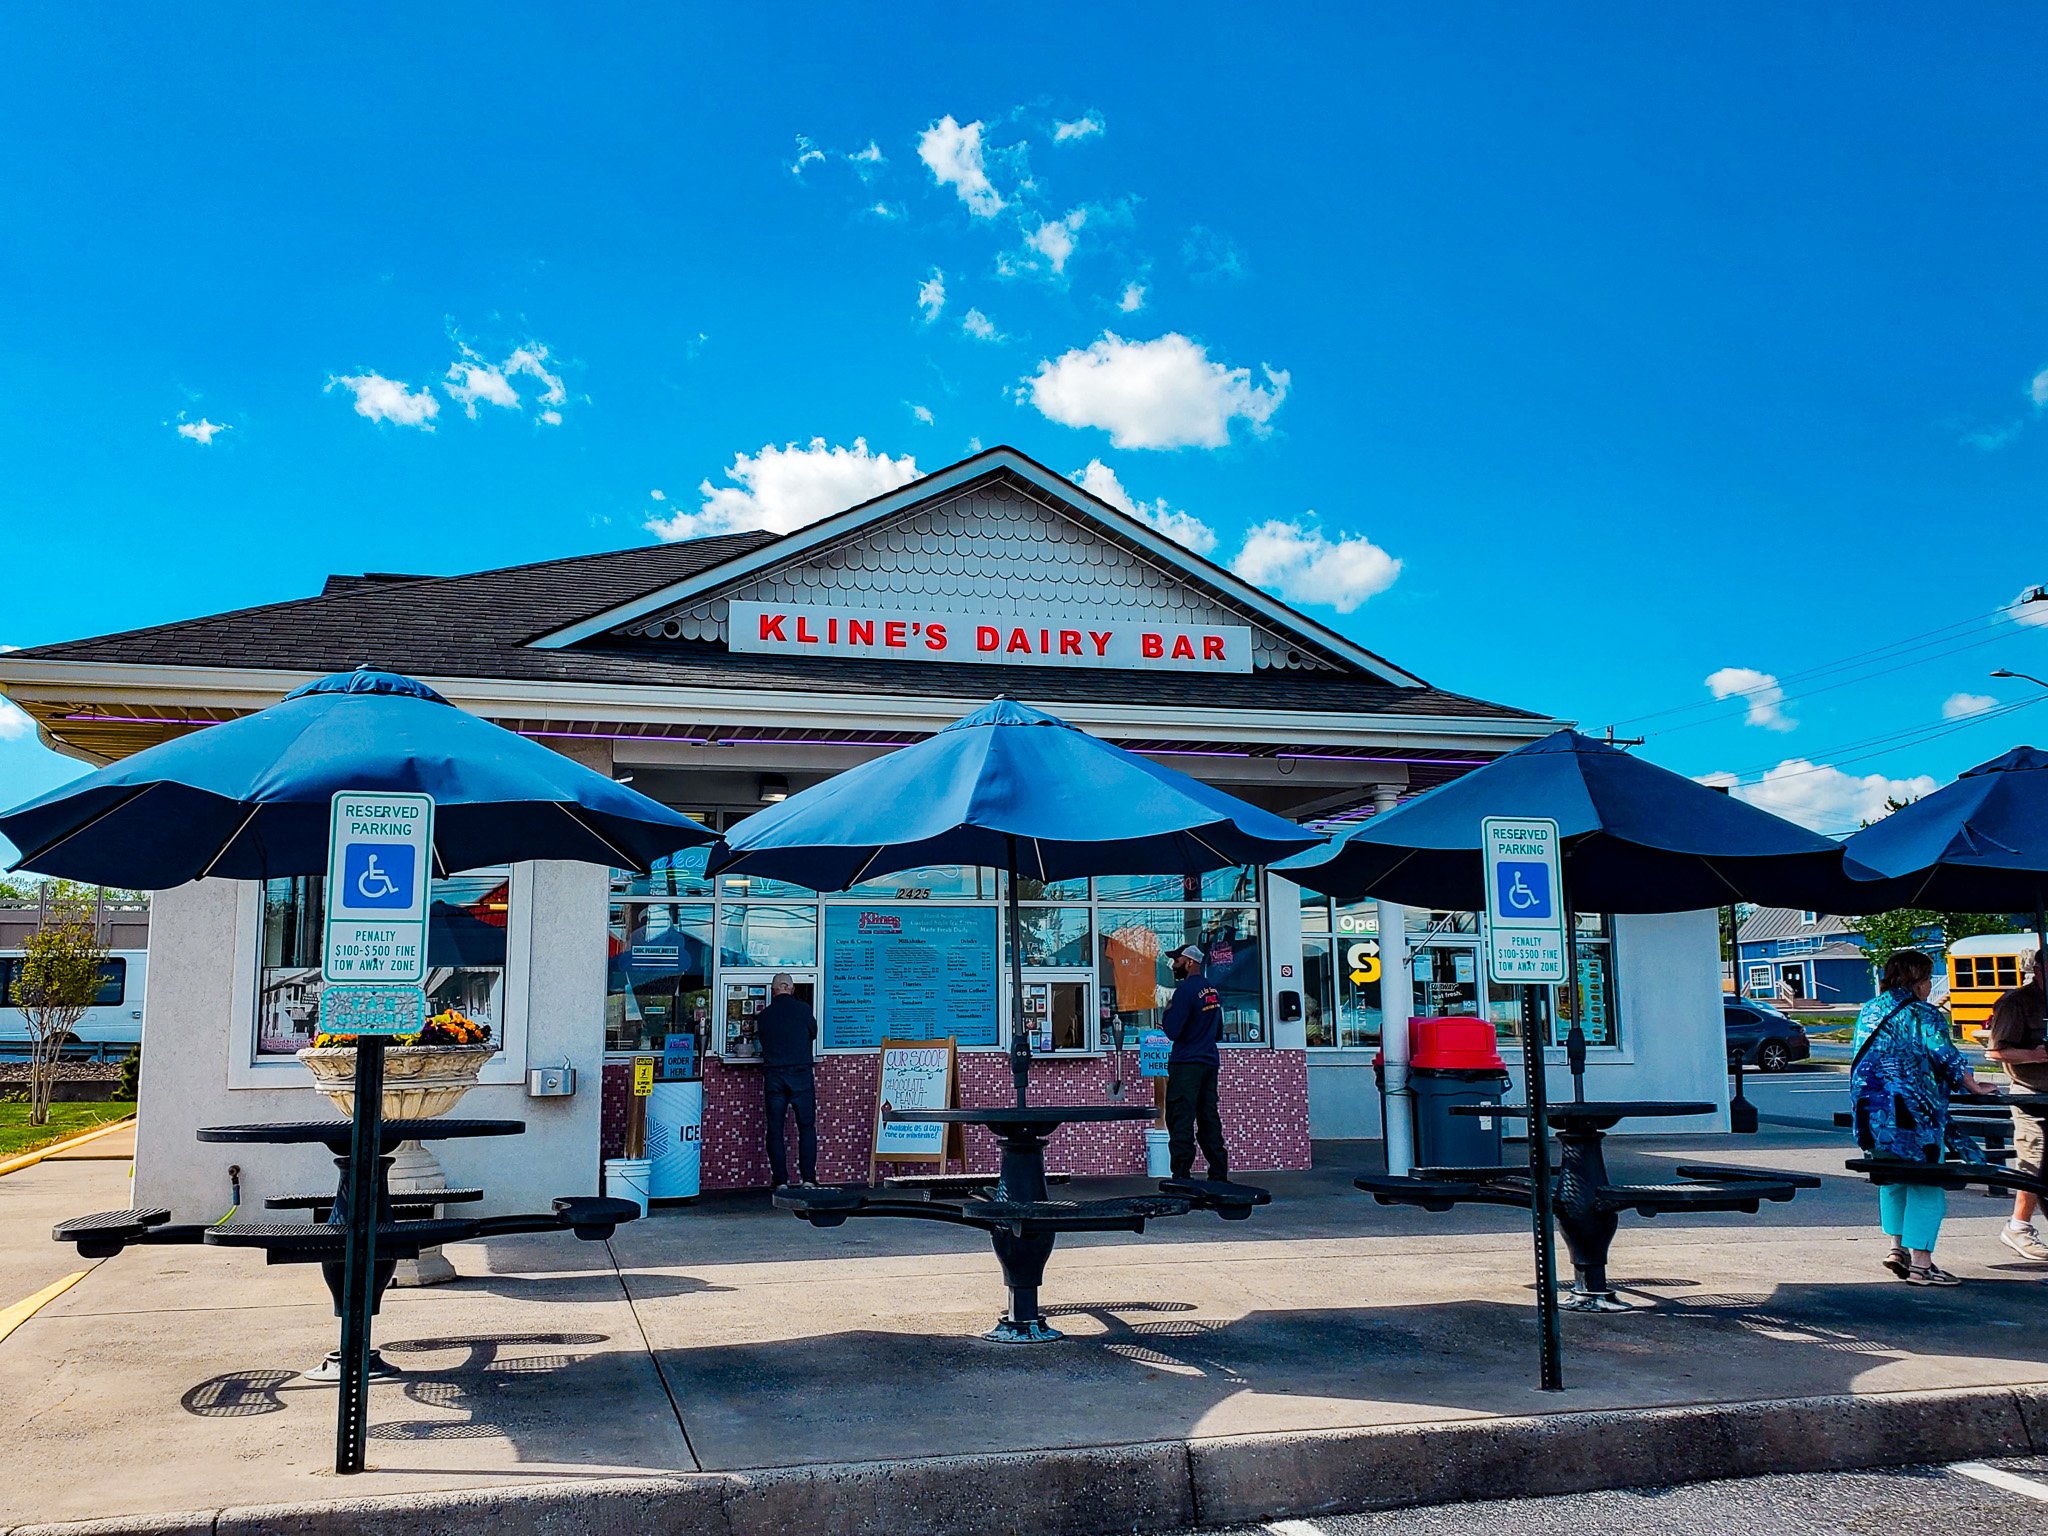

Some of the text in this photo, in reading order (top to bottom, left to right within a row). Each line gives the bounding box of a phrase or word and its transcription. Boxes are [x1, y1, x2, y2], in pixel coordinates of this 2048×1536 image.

[758, 613, 1226, 661] KLINE'S DAIRY BAR
[345, 805, 419, 819] RESERVED
[351, 822, 412, 836] PARKING
[1493, 828, 1548, 841] RESERVED
[1498, 843, 1544, 855] PARKING
[897, 888, 931, 900] 2425
[355, 931, 396, 942] PENALTY
[1511, 936, 1542, 946] PENALTY
[335, 945, 416, 957] $100-$500 FINE
[1498, 949, 1558, 960] $100-$500 FINE
[334, 959, 415, 971] TOW AWAY ZONE
[1498, 961, 1558, 972] TOW AWAY ZONE
[668, 1056, 690, 1066] ORDER
[887, 1049, 946, 1067] OUR SCOOP
[1143, 1052, 1161, 1060] PICK
[670, 1067, 687, 1077] HERE
[1148, 1062, 1169, 1070] HERE
[885, 1078, 926, 1092] CHOCOLATE
[894, 1091, 928, 1106] PEANUT
[913, 1124, 922, 1132] as
